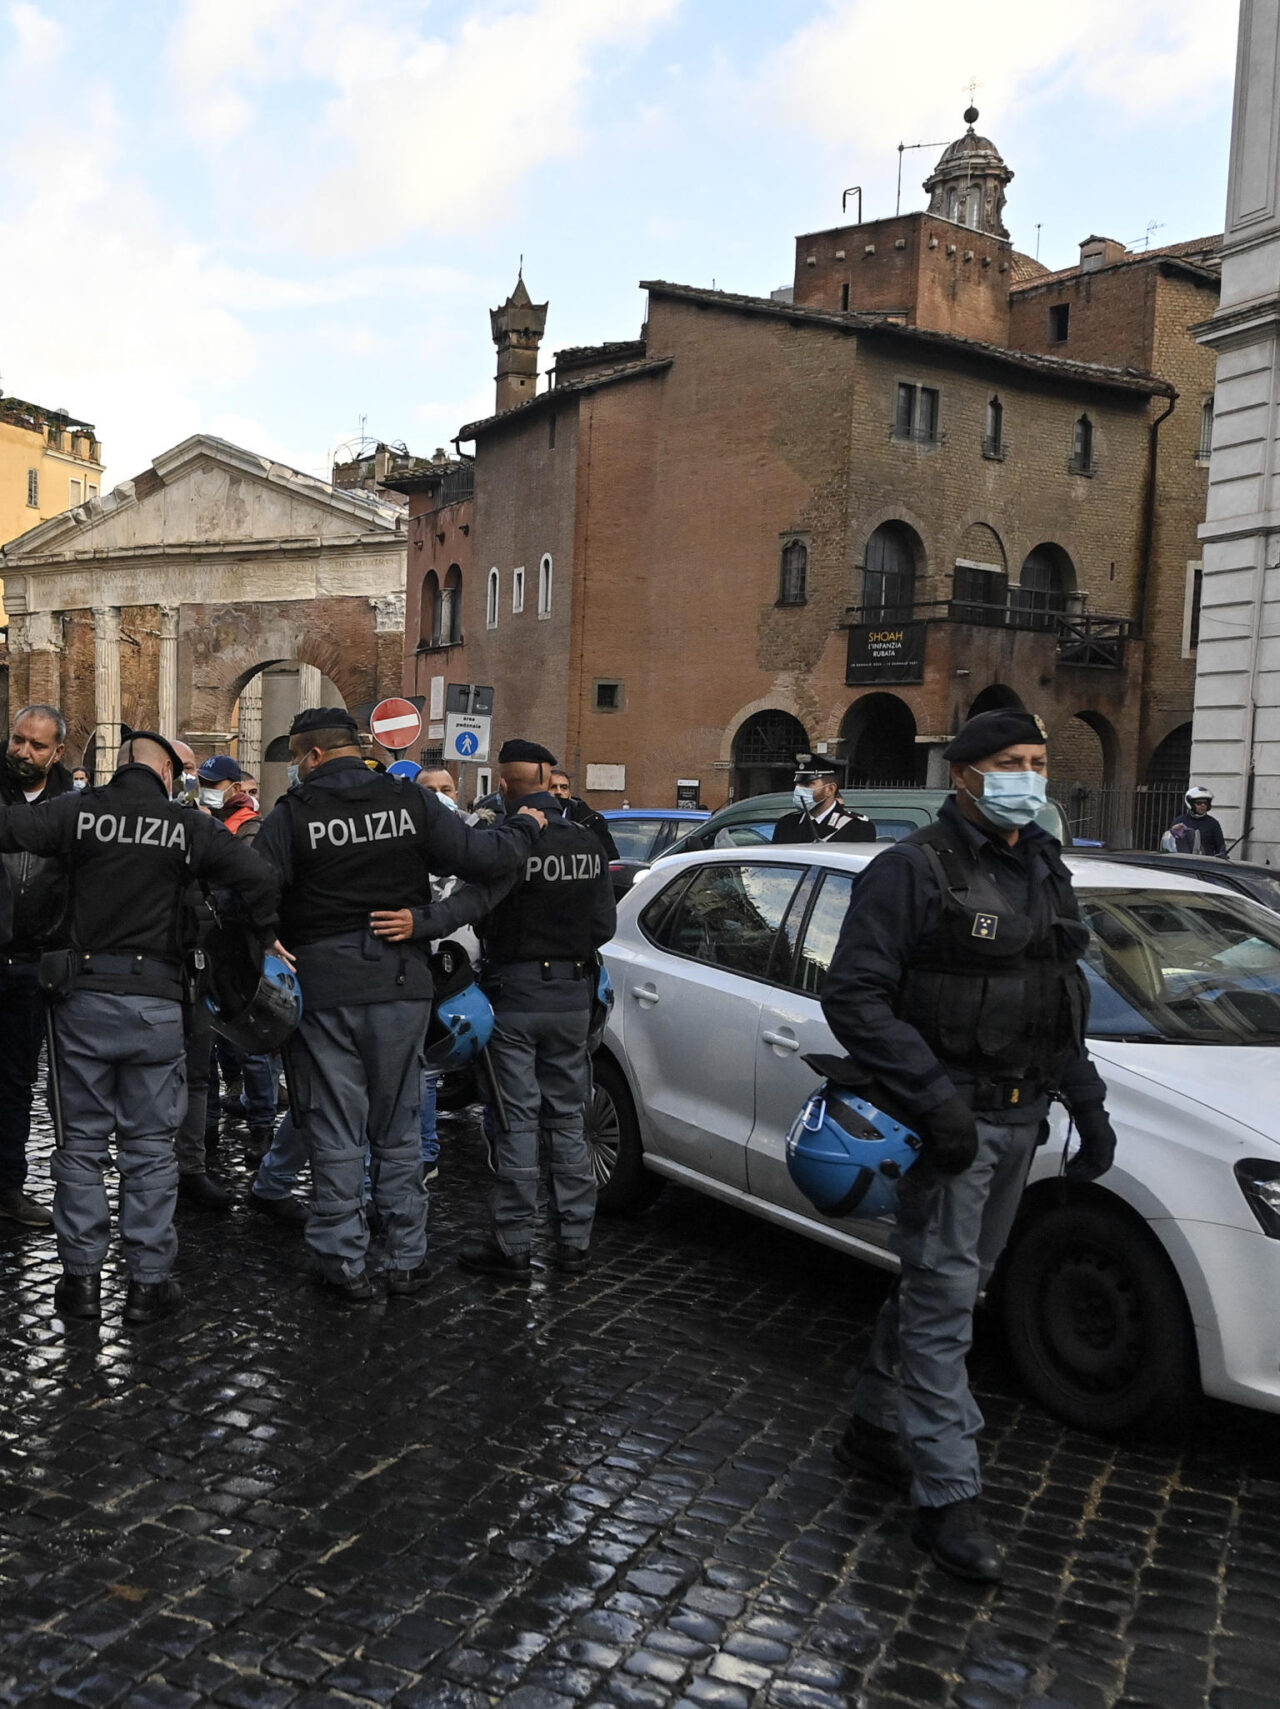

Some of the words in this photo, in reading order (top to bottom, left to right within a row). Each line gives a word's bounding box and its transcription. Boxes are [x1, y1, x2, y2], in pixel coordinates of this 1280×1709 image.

[869, 631, 903, 642] SHOAH
[76, 812, 186, 851] POLIZIA
[308, 808, 417, 849] POLIZIA
[525, 854, 601, 881] POLIZIA
